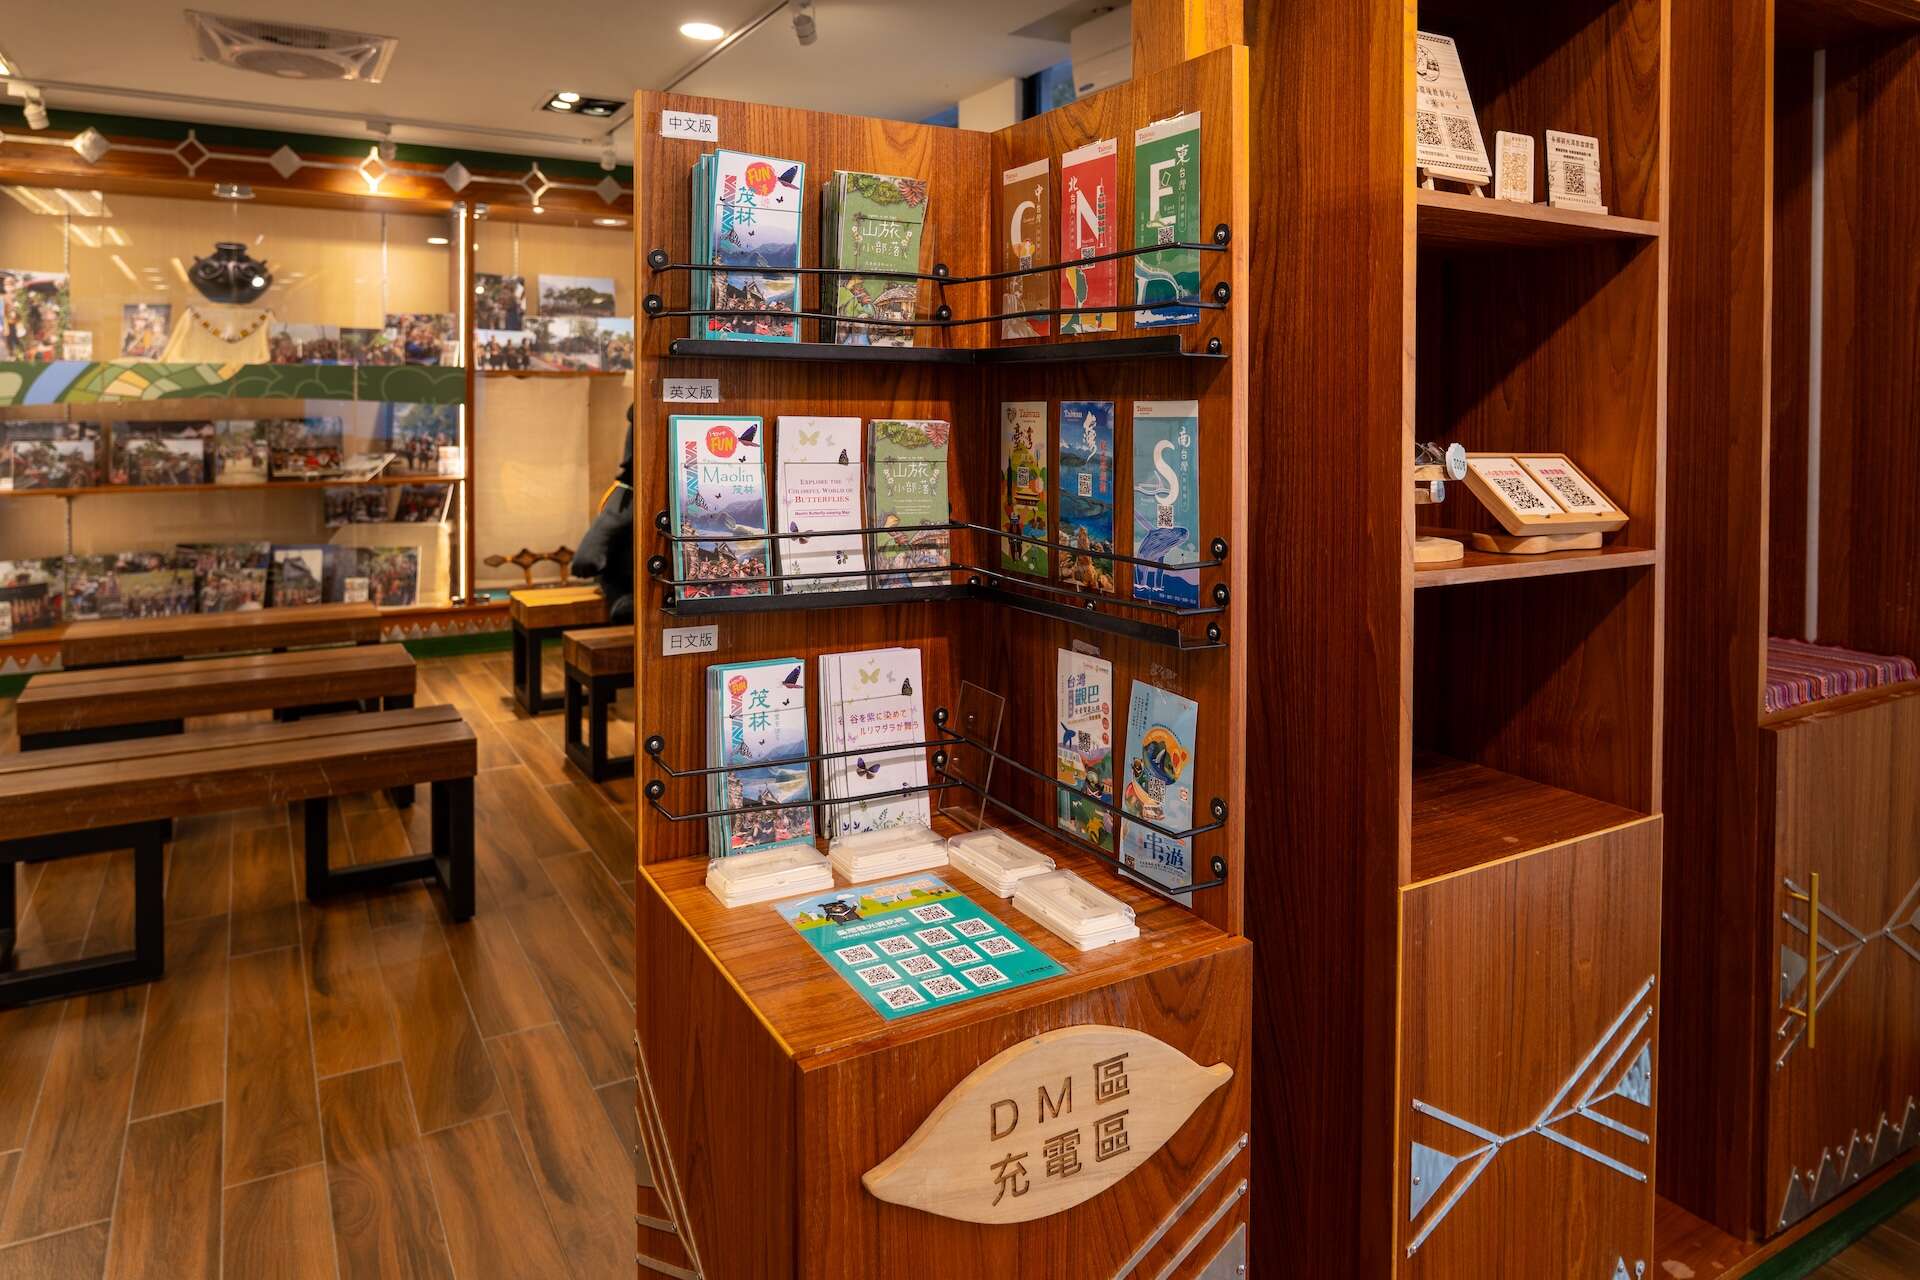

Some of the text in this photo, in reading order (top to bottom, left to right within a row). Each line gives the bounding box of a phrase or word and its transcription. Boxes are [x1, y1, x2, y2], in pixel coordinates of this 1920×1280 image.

[669, 116, 712, 134] 中文版
[734, 186, 757, 227] 茂林
[862, 219, 901, 239] 山旅
[669, 385, 714, 400] 英文版
[703, 465, 754, 484] Maolin
[893, 461, 929, 479] 山旅
[795, 496, 850, 504] BUTTERFLIES
[670, 632, 713, 649] 日文版
[748, 688, 771, 732] 茂林
[989, 1109, 1131, 1207] 充電區
